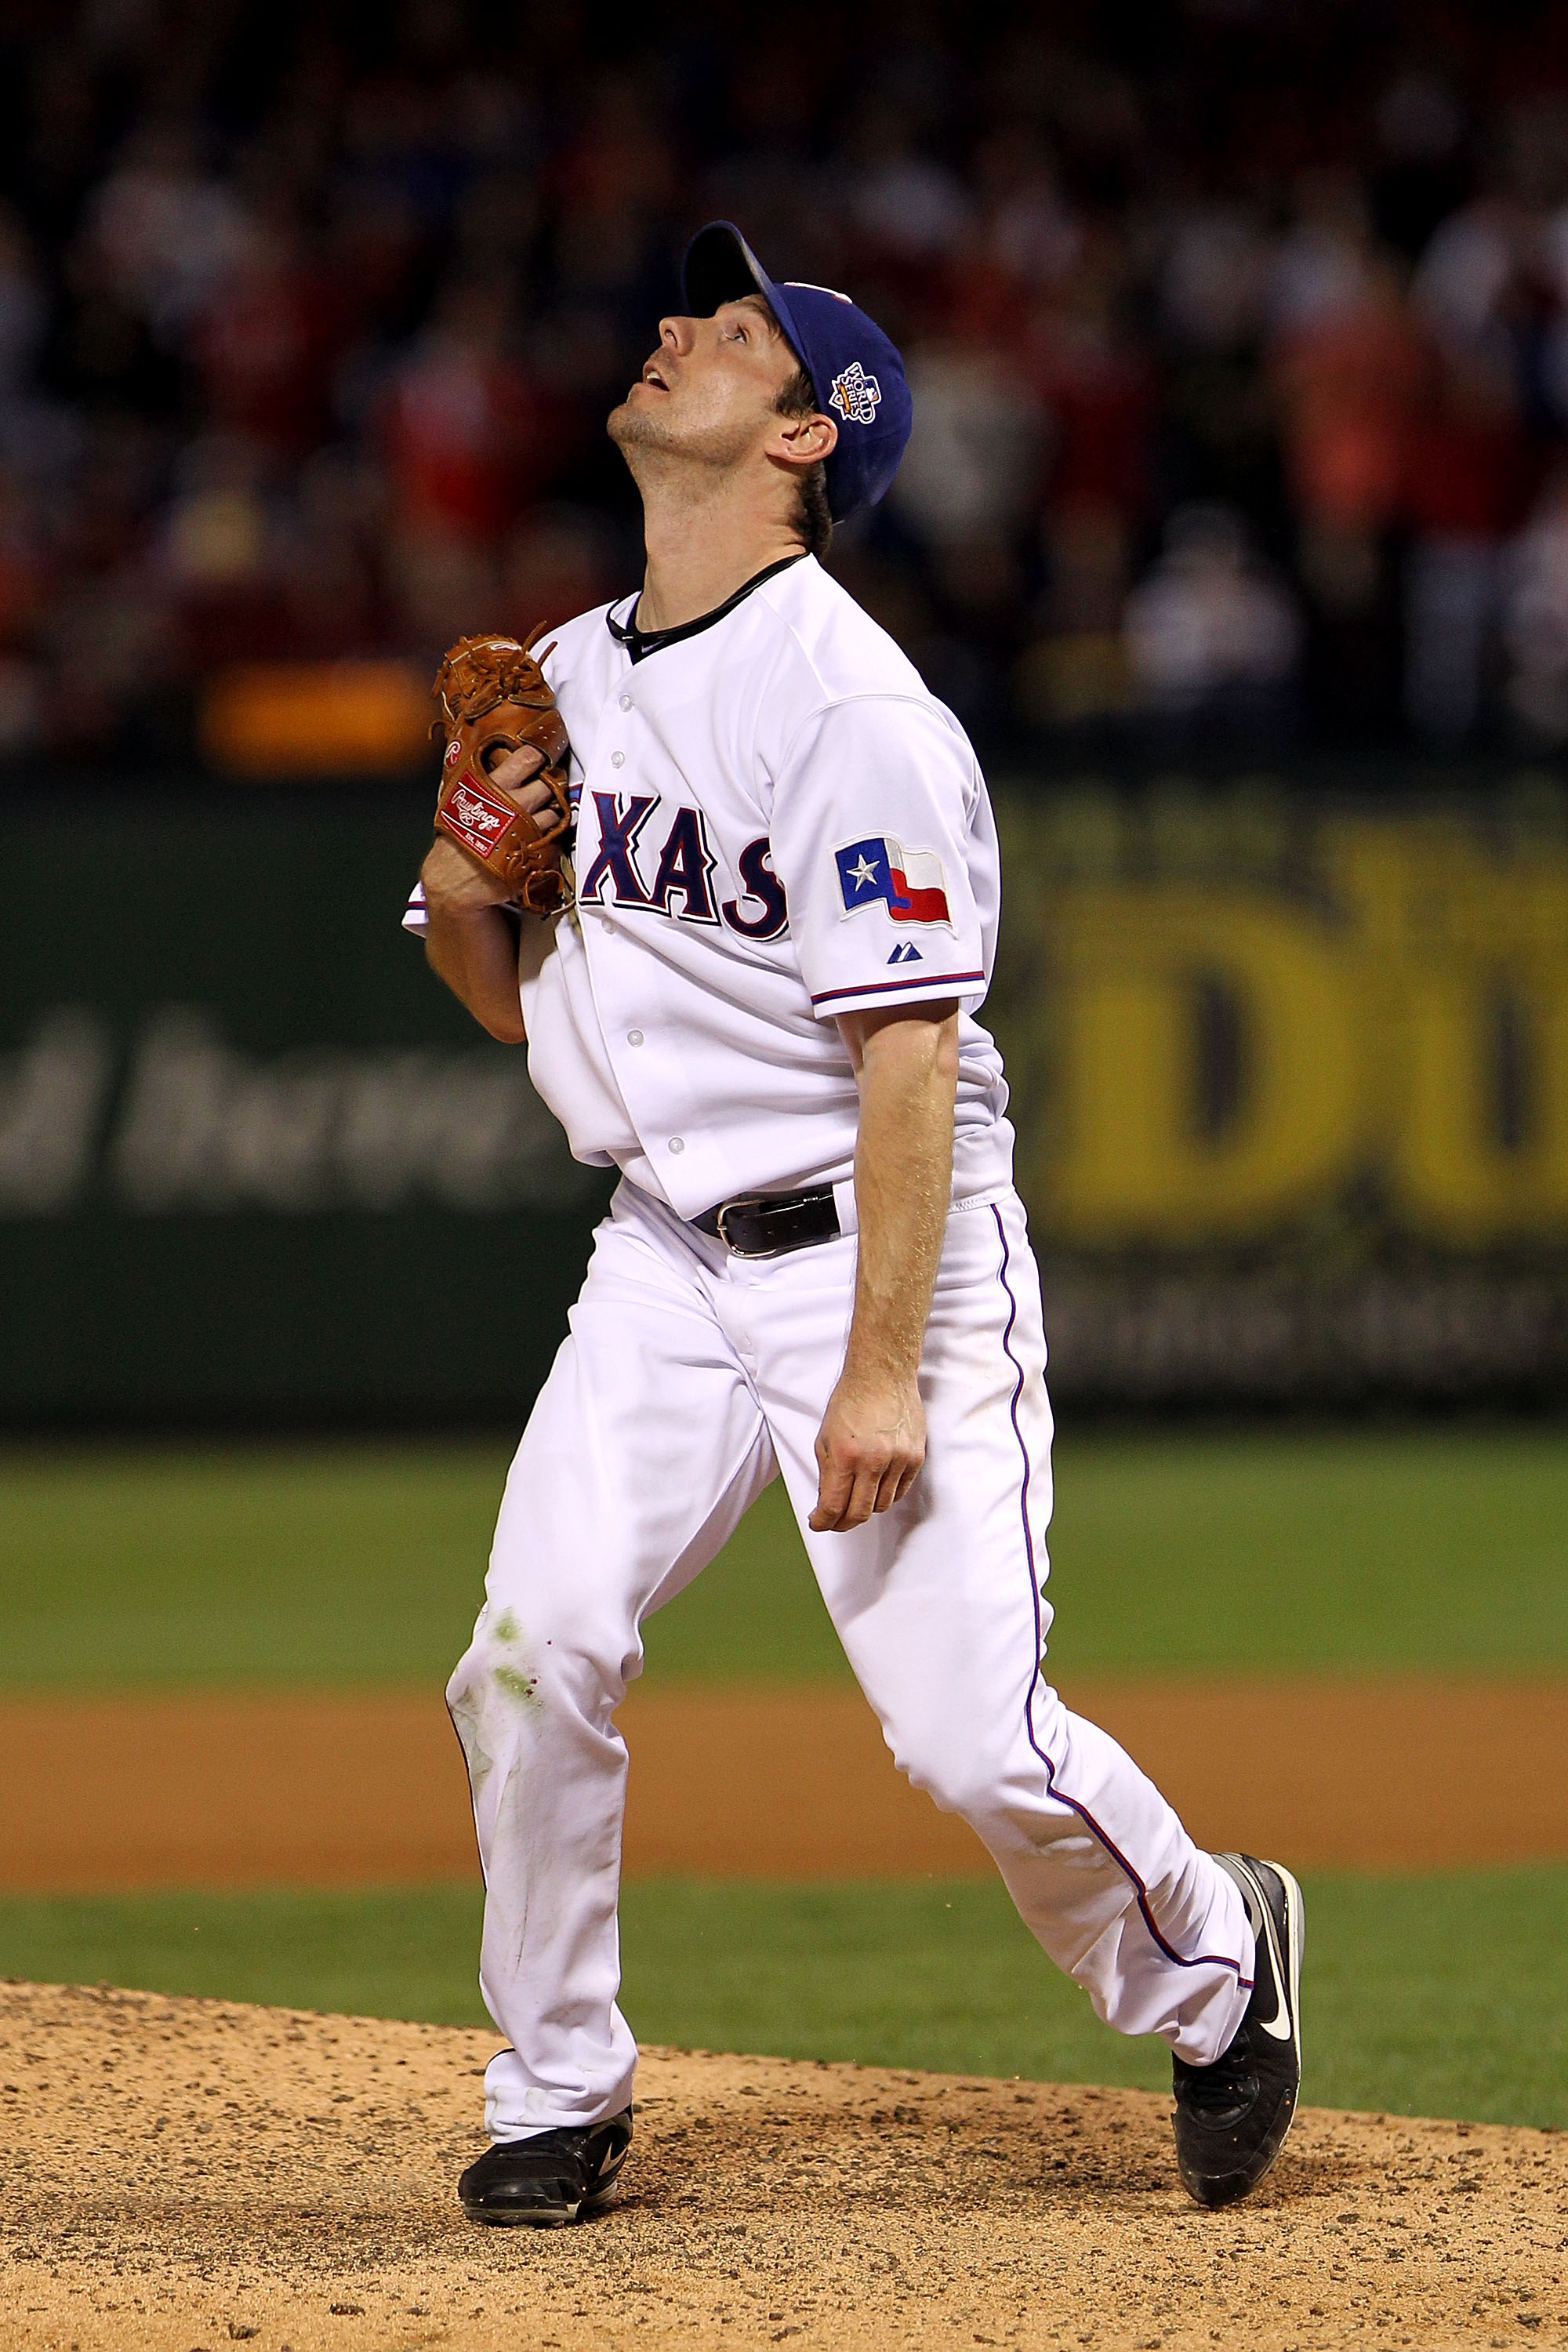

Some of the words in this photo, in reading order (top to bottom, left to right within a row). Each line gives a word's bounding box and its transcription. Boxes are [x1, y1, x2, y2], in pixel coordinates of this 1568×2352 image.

[841, 376, 859, 417] SERIES
[848, 365, 873, 420] WORLD
[451, 789, 501, 830] Rawlings
[571, 787, 789, 942] XAS
